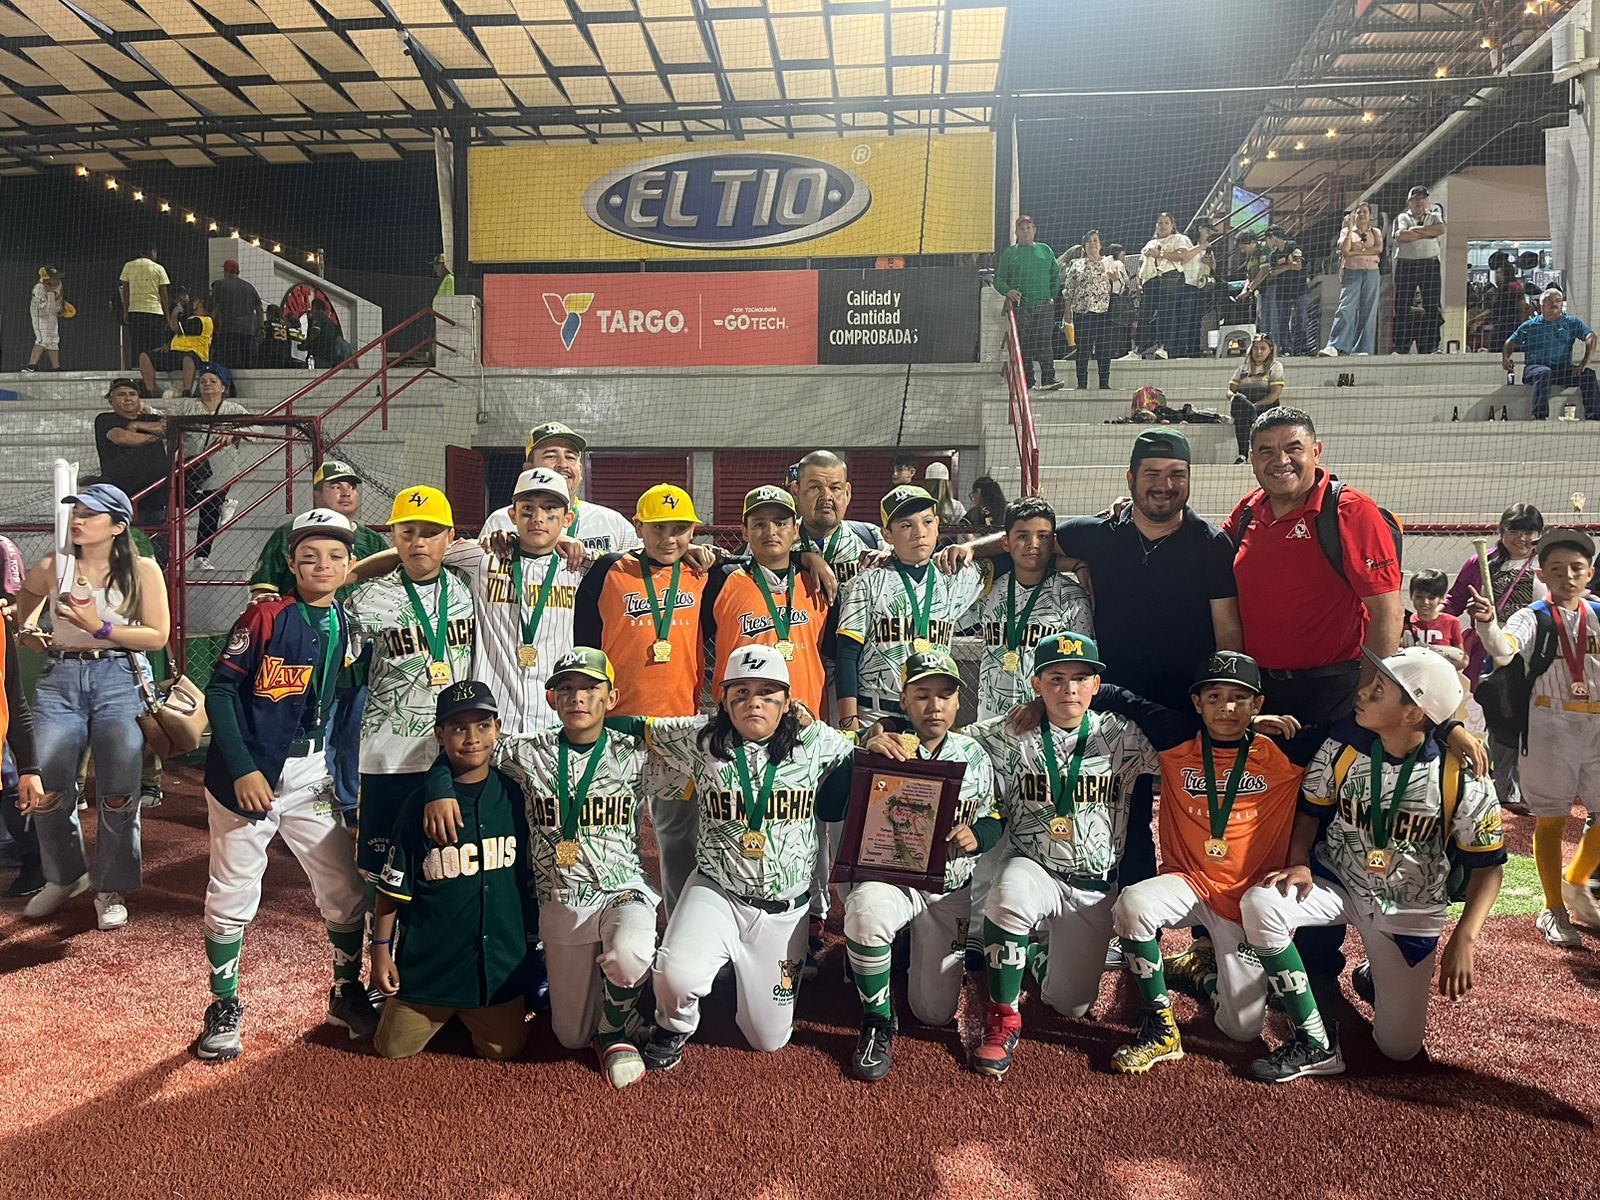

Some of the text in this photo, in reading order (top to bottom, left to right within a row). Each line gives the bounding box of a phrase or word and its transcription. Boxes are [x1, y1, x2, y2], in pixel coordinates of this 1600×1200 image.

[624, 168, 828, 228] EL TIO
[847, 289, 901, 308] Calidad y
[597, 310, 684, 334] TARGO
[724, 314, 786, 330] GOTECH
[847, 309, 900, 325] Cantidad
[530, 470, 553, 485] LV
[631, 619, 690, 627] BASALL
[741, 651, 767, 671] LV
[374, 843, 386, 853] 33
